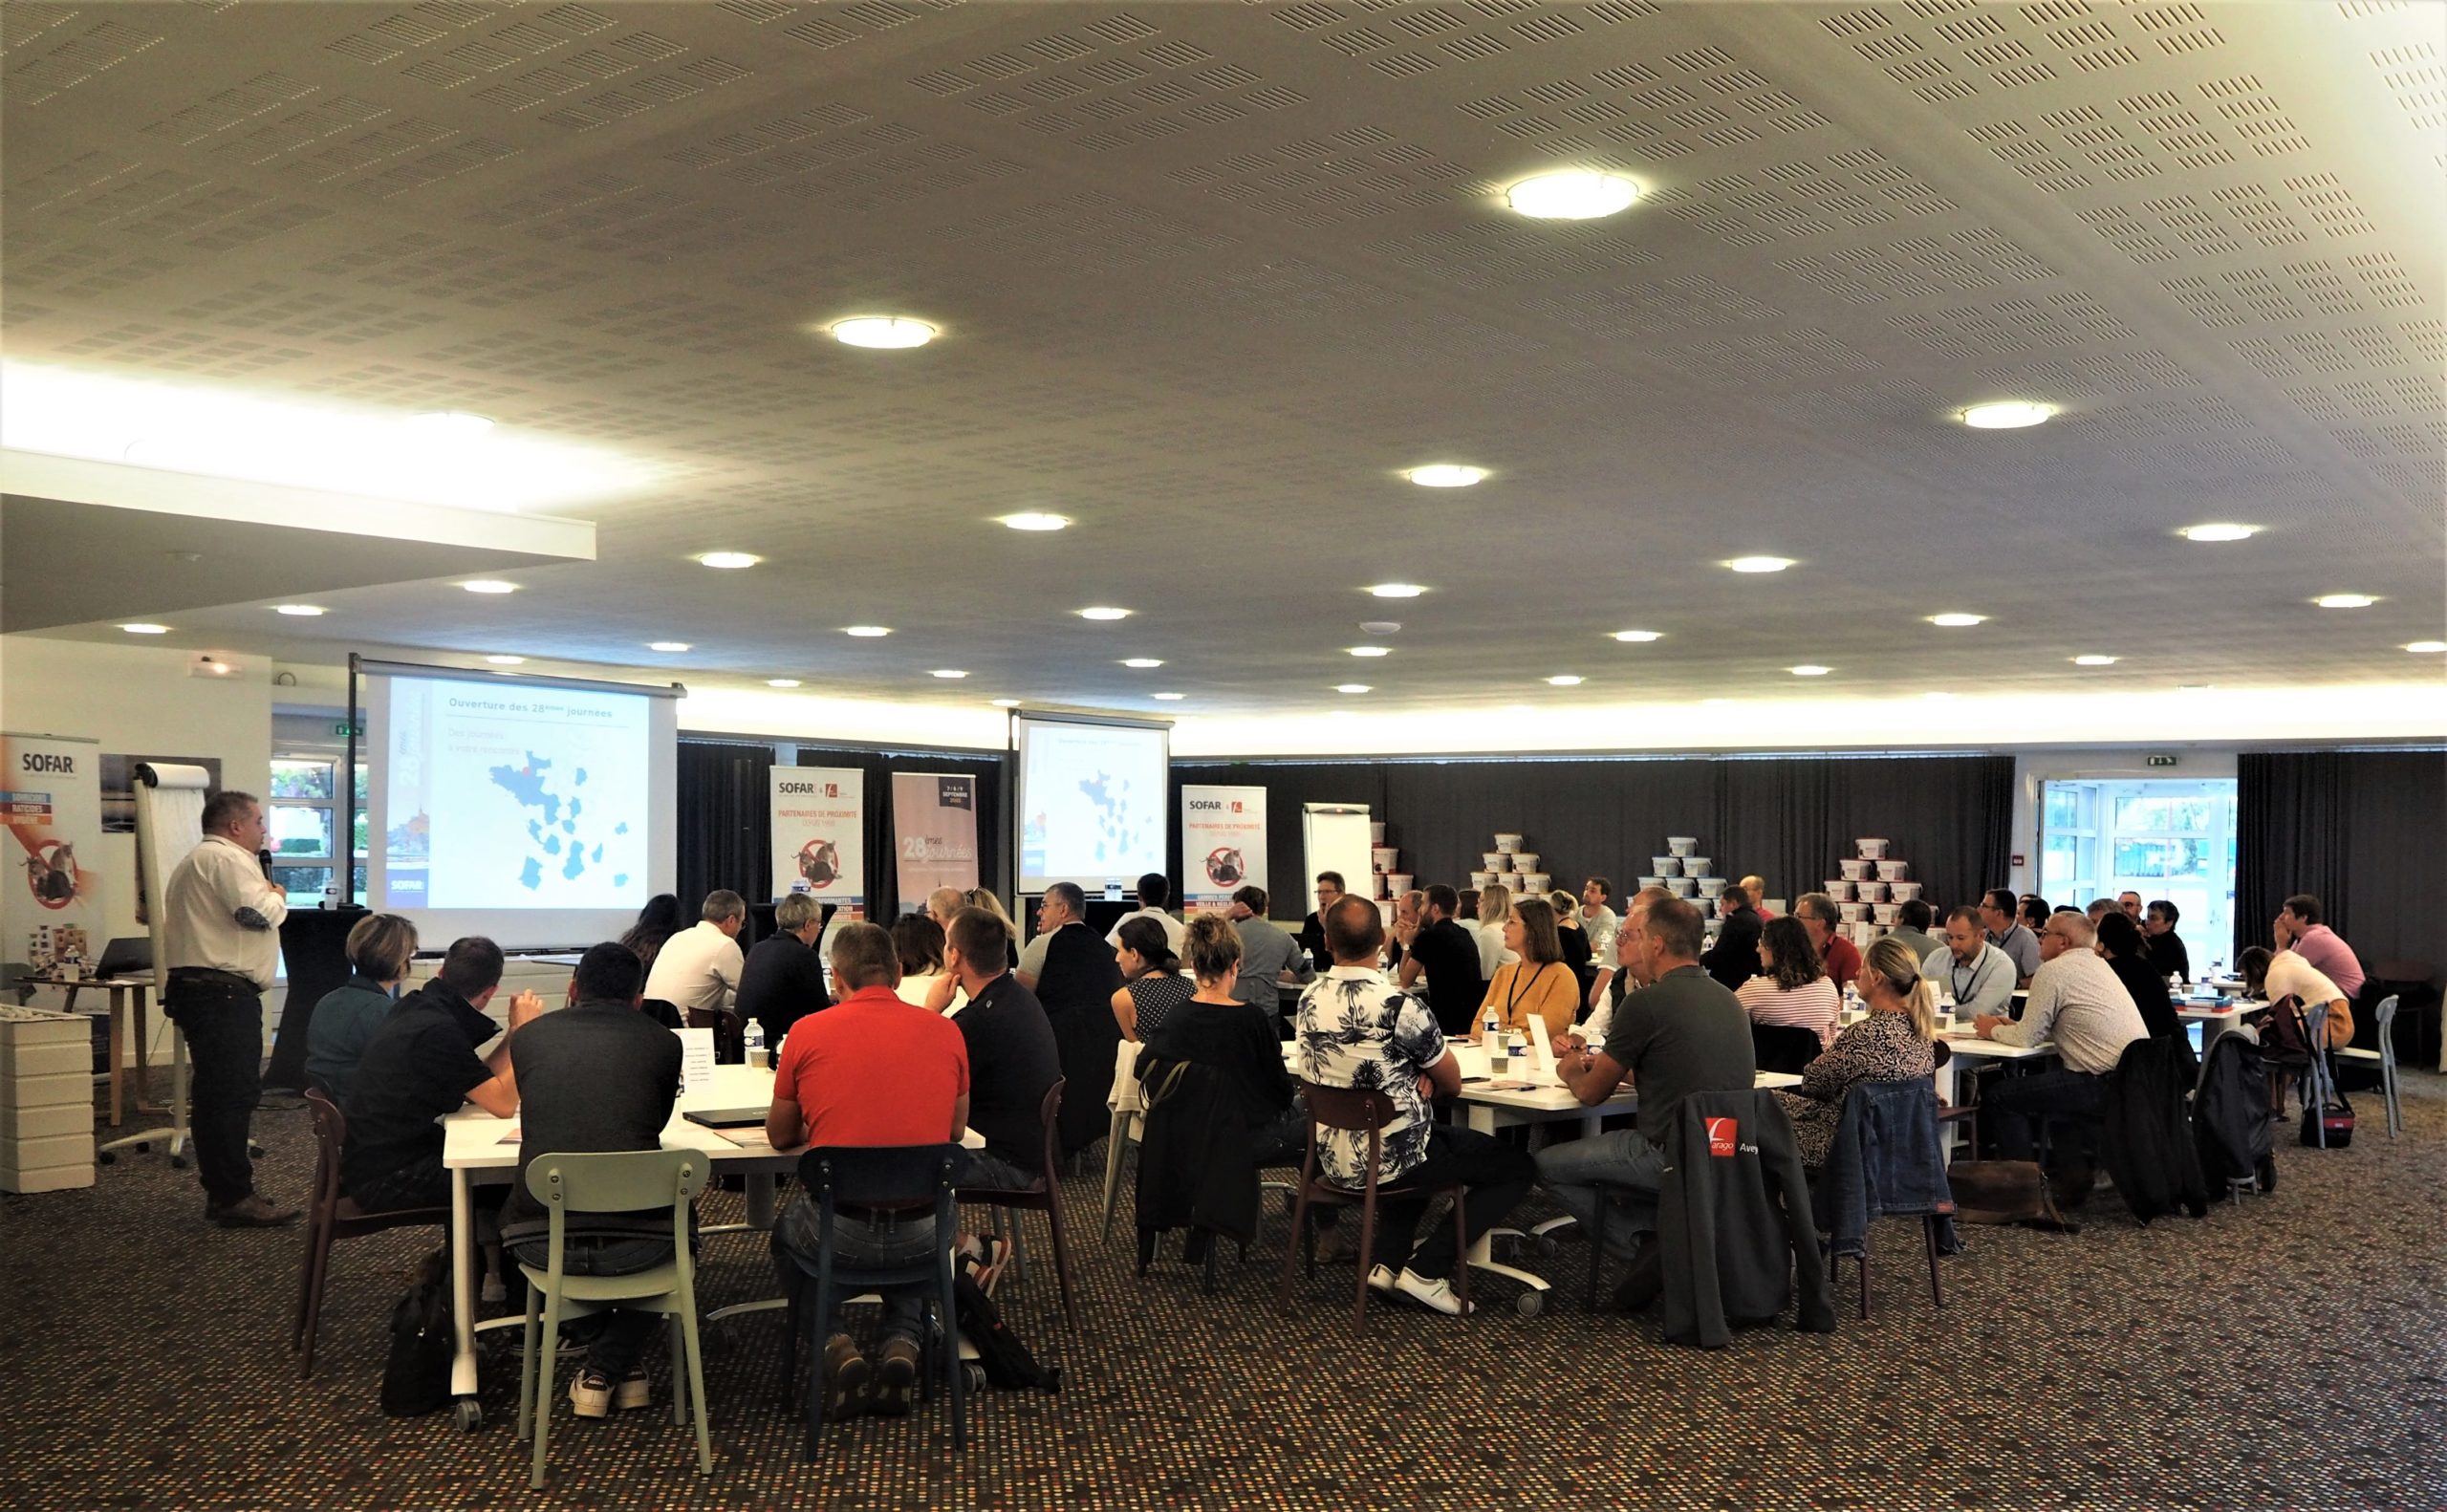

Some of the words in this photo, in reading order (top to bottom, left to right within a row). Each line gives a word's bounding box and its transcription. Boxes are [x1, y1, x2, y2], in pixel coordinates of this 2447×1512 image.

[449, 698, 506, 711] Ouverture
[509, 702, 528, 712] des
[23, 753, 74, 773] SOFAR
[779, 782, 814, 794] SOFAR
[1189, 800, 1222, 810] SOFAR
[778, 810, 817, 818] PARTENAIRES
[902, 836, 926, 858] 28
[391, 879, 423, 890] SOFAR
